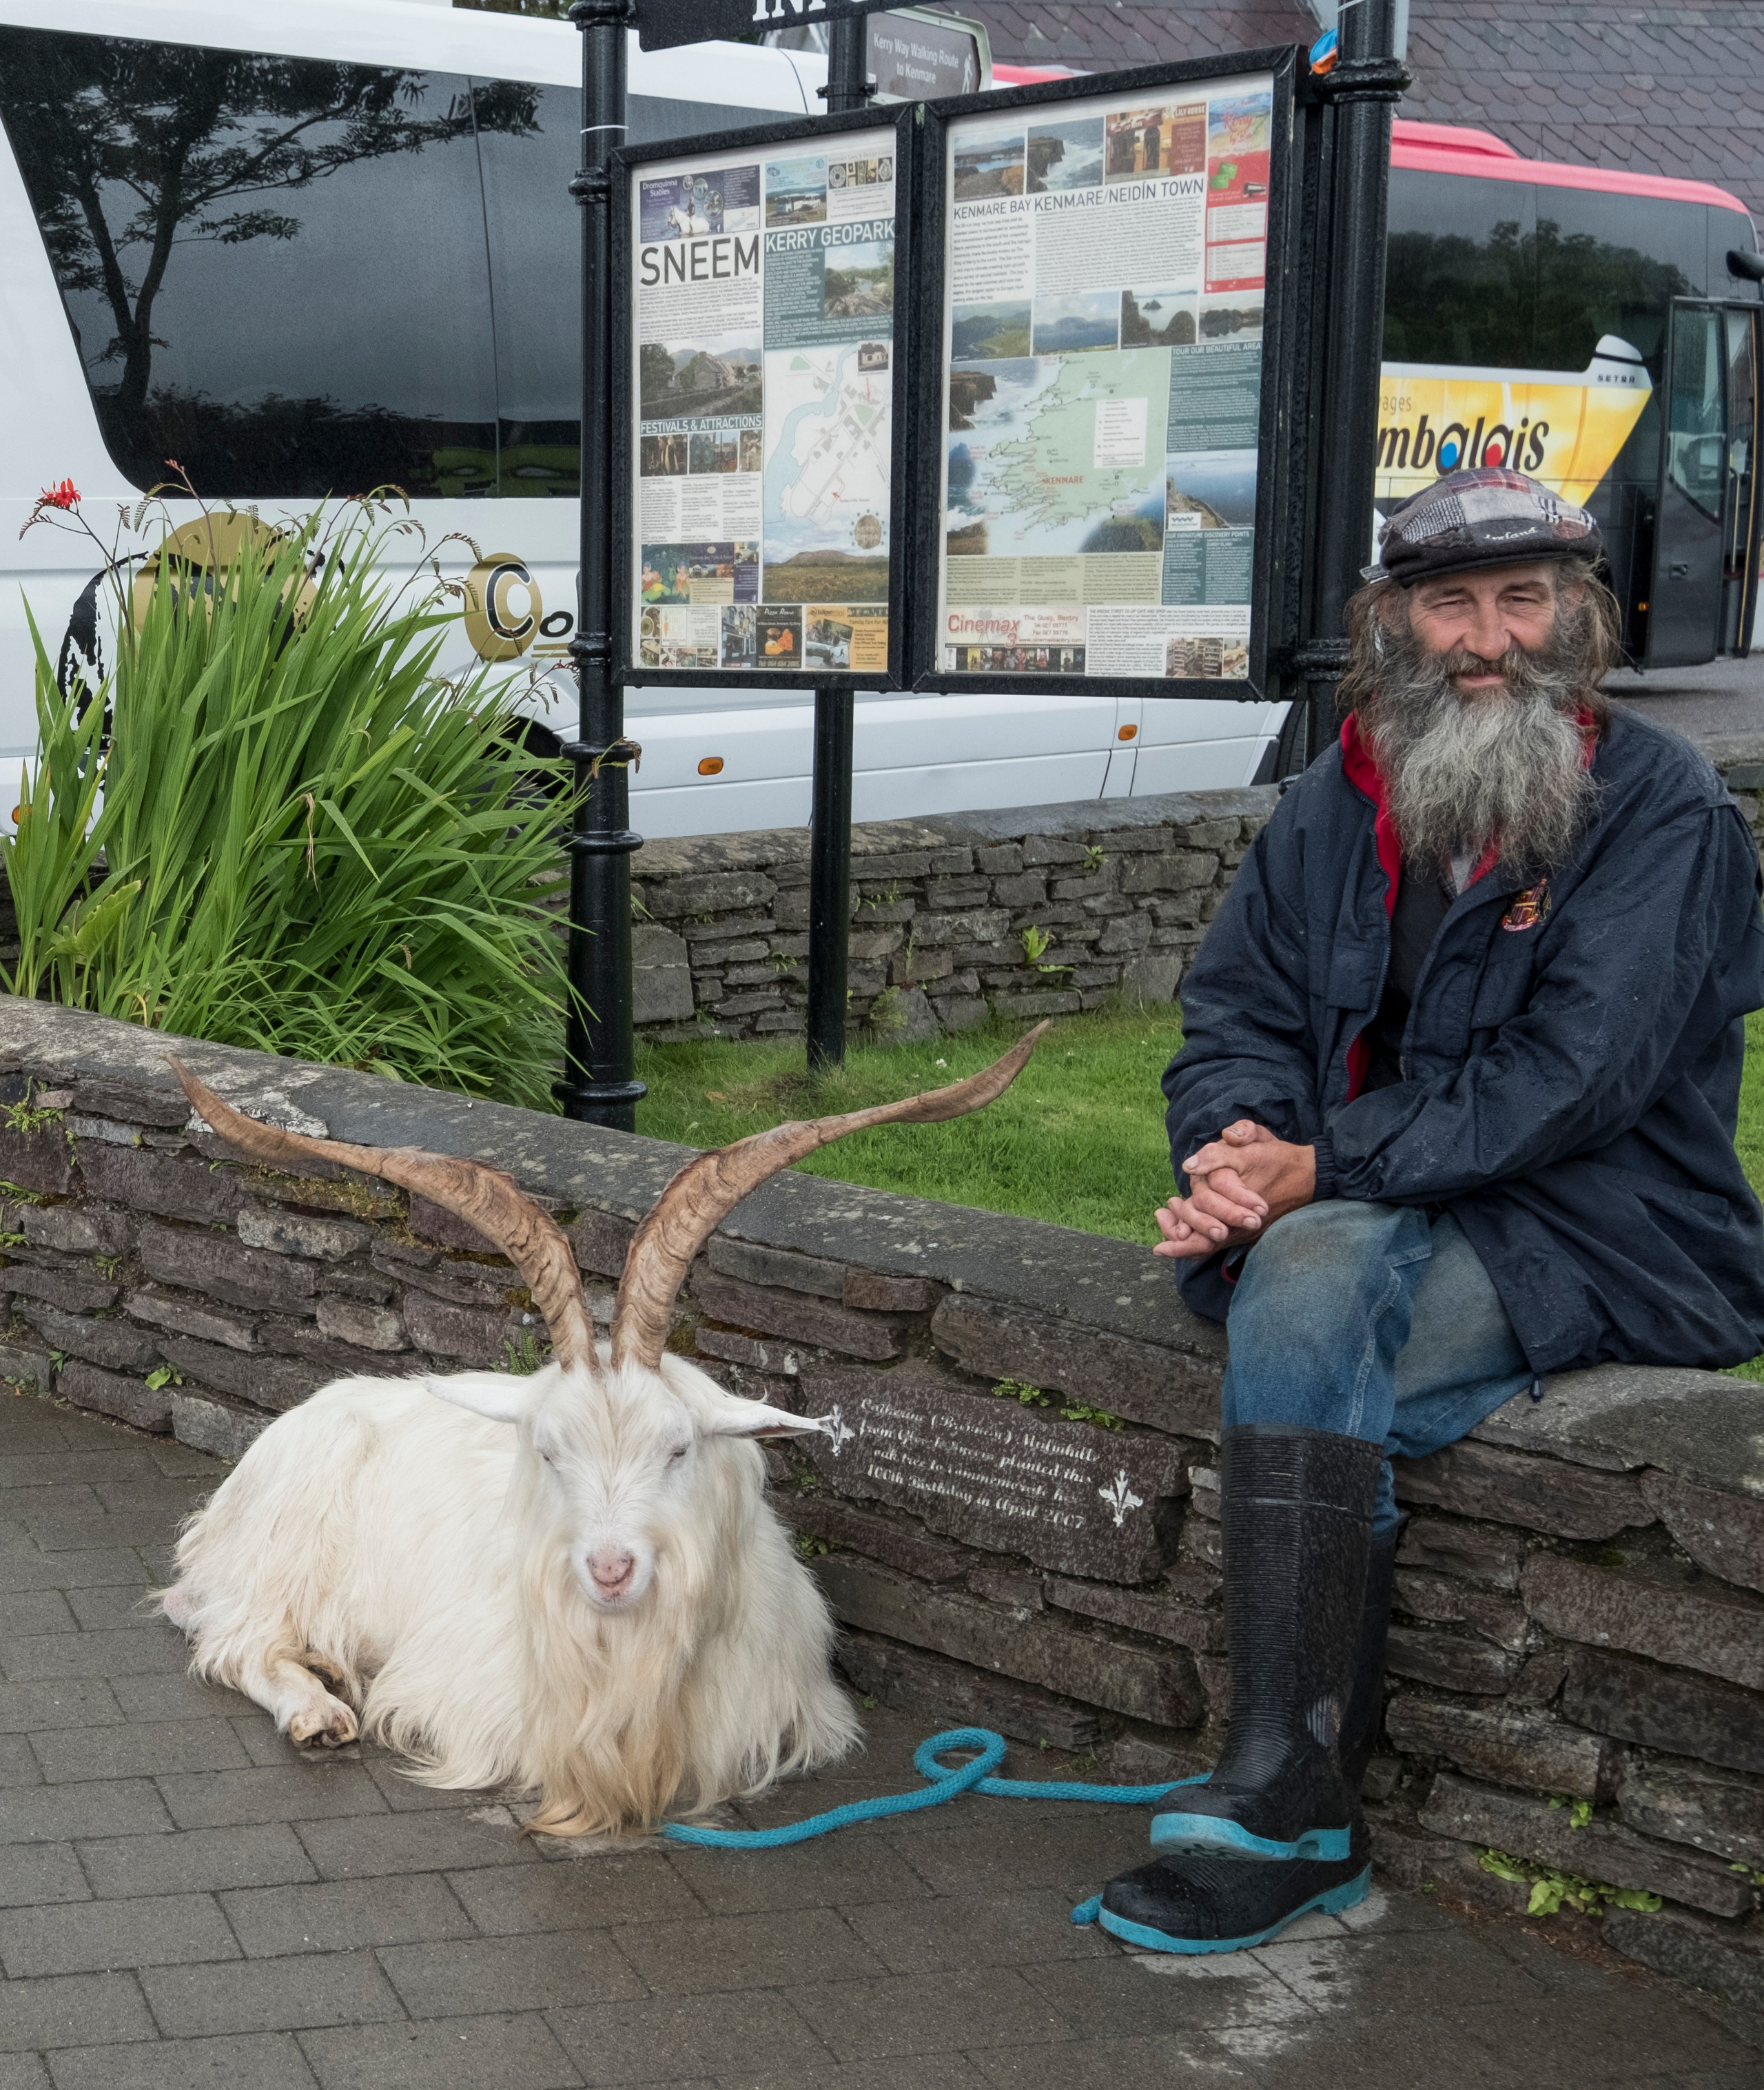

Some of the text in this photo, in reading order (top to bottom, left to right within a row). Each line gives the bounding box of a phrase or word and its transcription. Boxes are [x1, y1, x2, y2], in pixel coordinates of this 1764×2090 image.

[874, 32, 958, 68] Kerry Way Walking Route
[896, 62, 936, 84] to Kenmare
[650, 189, 670, 197] Stables
[1161, 178, 1204, 197] TOWN
[954, 198, 1032, 220] KENMARE BAY
[766, 229, 817, 253] KERRY
[821, 219, 895, 246] GEOPARK
[640, 234, 759, 286] SNEEM
[1172, 347, 1189, 356] TOUR
[1205, 345, 1241, 354] BEAUTIFUL
[1382, 396, 1412, 416] ages
[640, 416, 762, 433] FESTIVALS & ATTRACTIONS
[1046, 475, 1084, 484] KENMARE
[947, 614, 1021, 633] Cinemax
[1005, 633, 1018, 648] 3
[860, 1419, 893, 1438] from
[999, 1454, 1060, 1477] planted
[902, 1453, 926, 1468] tree
[930, 1459, 943, 1471] to
[868, 1464, 903, 1484] 100th
[908, 1475, 972, 1505] Birthday
[976, 1494, 990, 1507] in
[996, 1497, 1038, 1517] April
